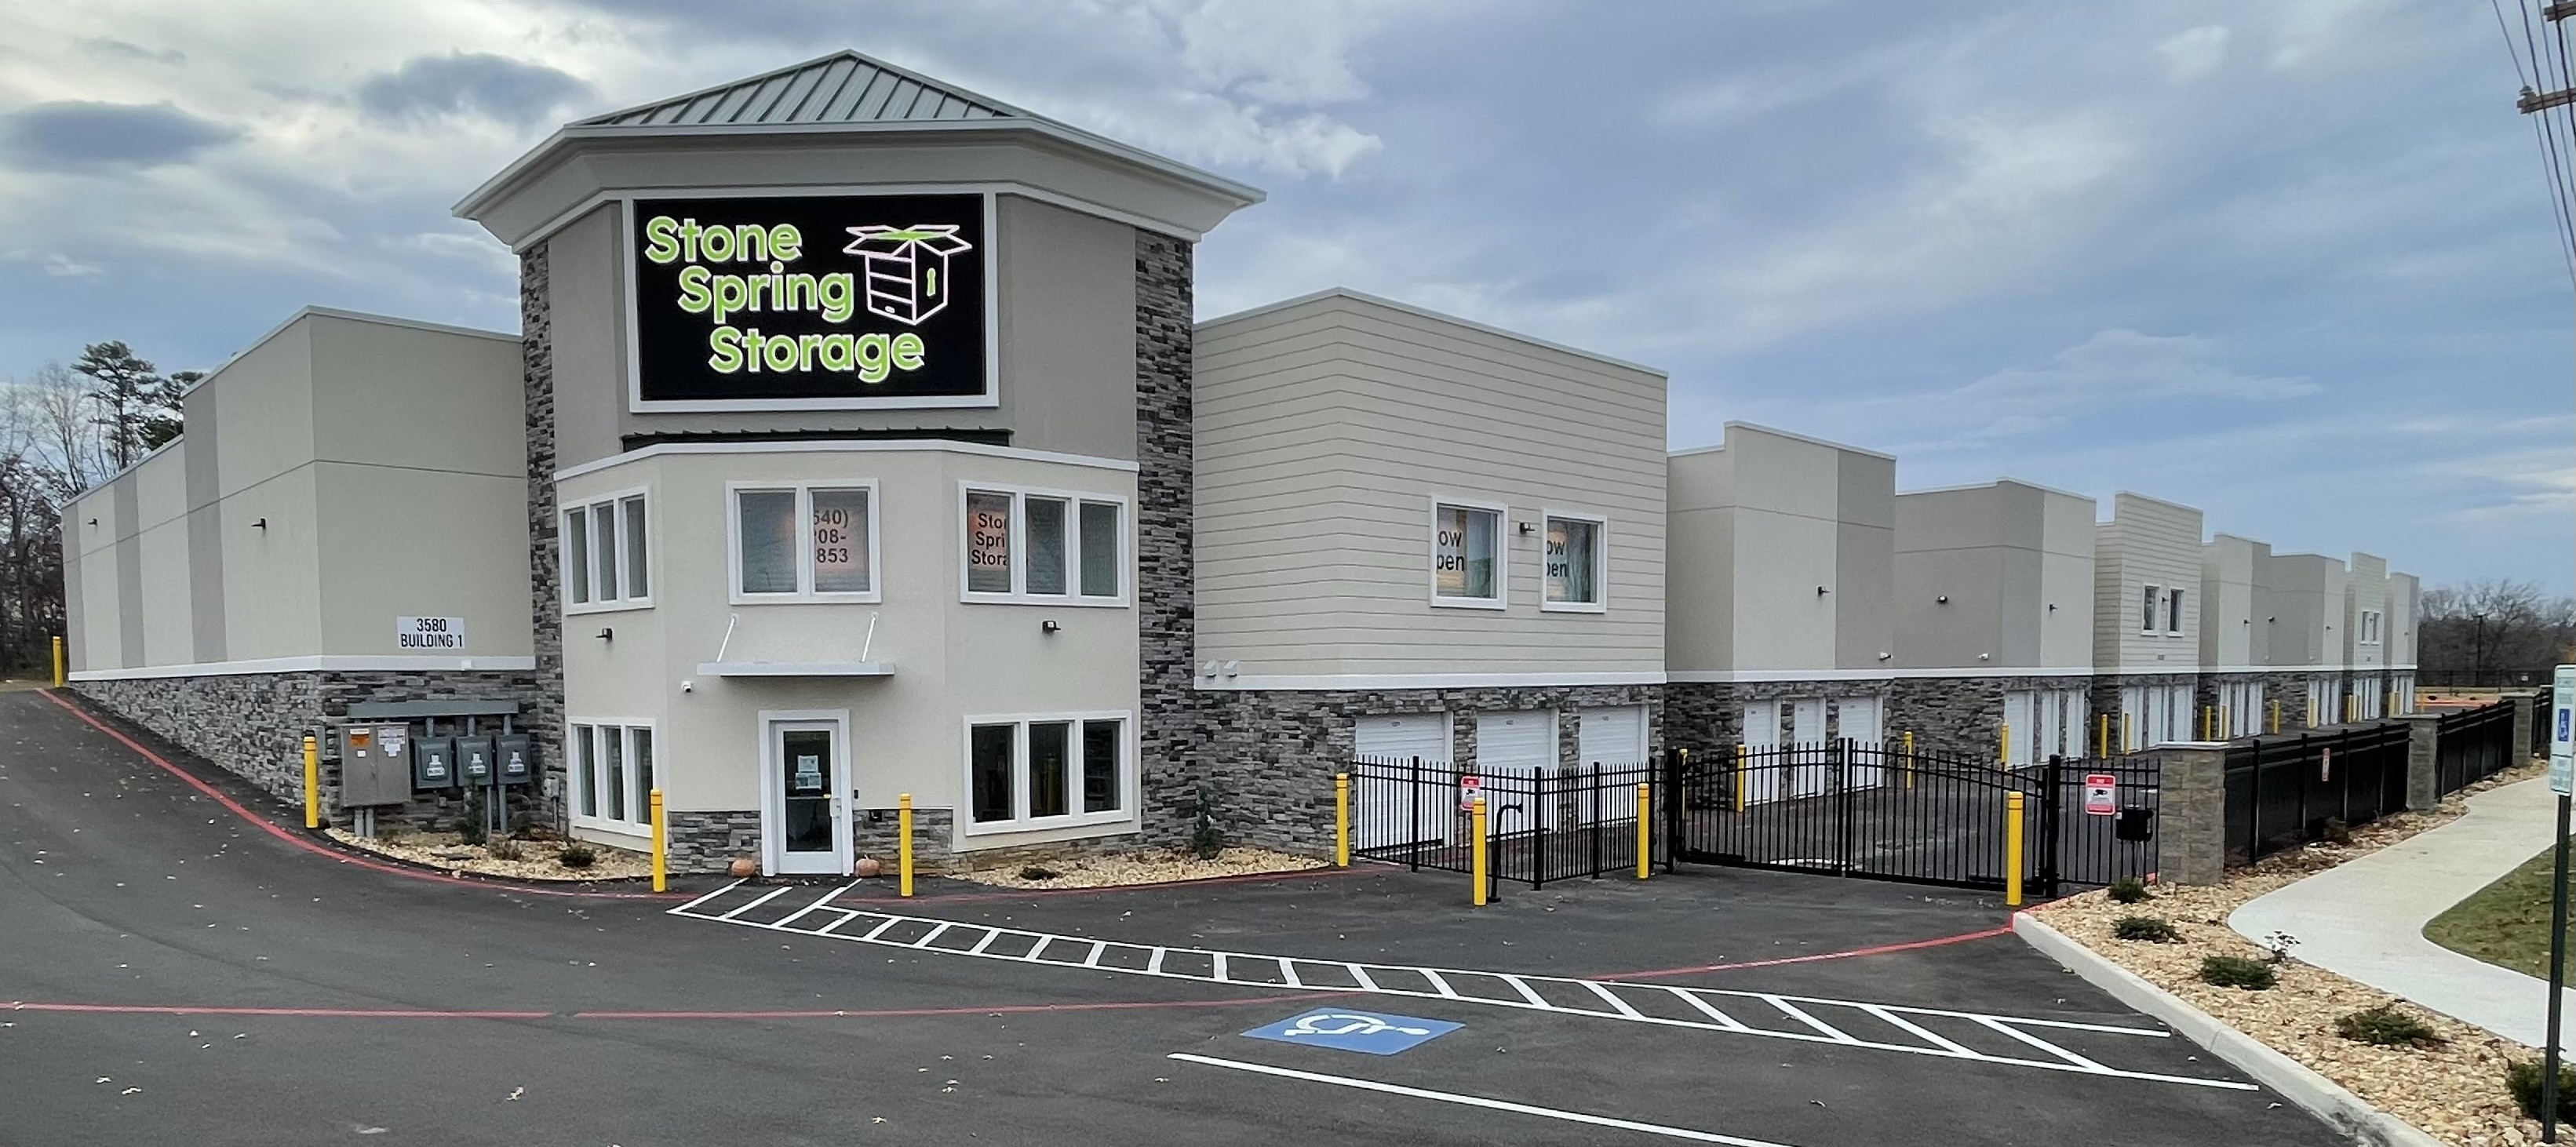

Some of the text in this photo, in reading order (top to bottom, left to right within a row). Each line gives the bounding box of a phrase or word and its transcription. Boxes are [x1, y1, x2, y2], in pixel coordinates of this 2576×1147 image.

[645, 216, 803, 264] Stone
[678, 261, 854, 323] Spring
[709, 326, 925, 384] Storage
[814, 529, 847, 544] 08-
[400, 633, 462, 648] BUILDING 1
[417, 618, 446, 632] 3580
